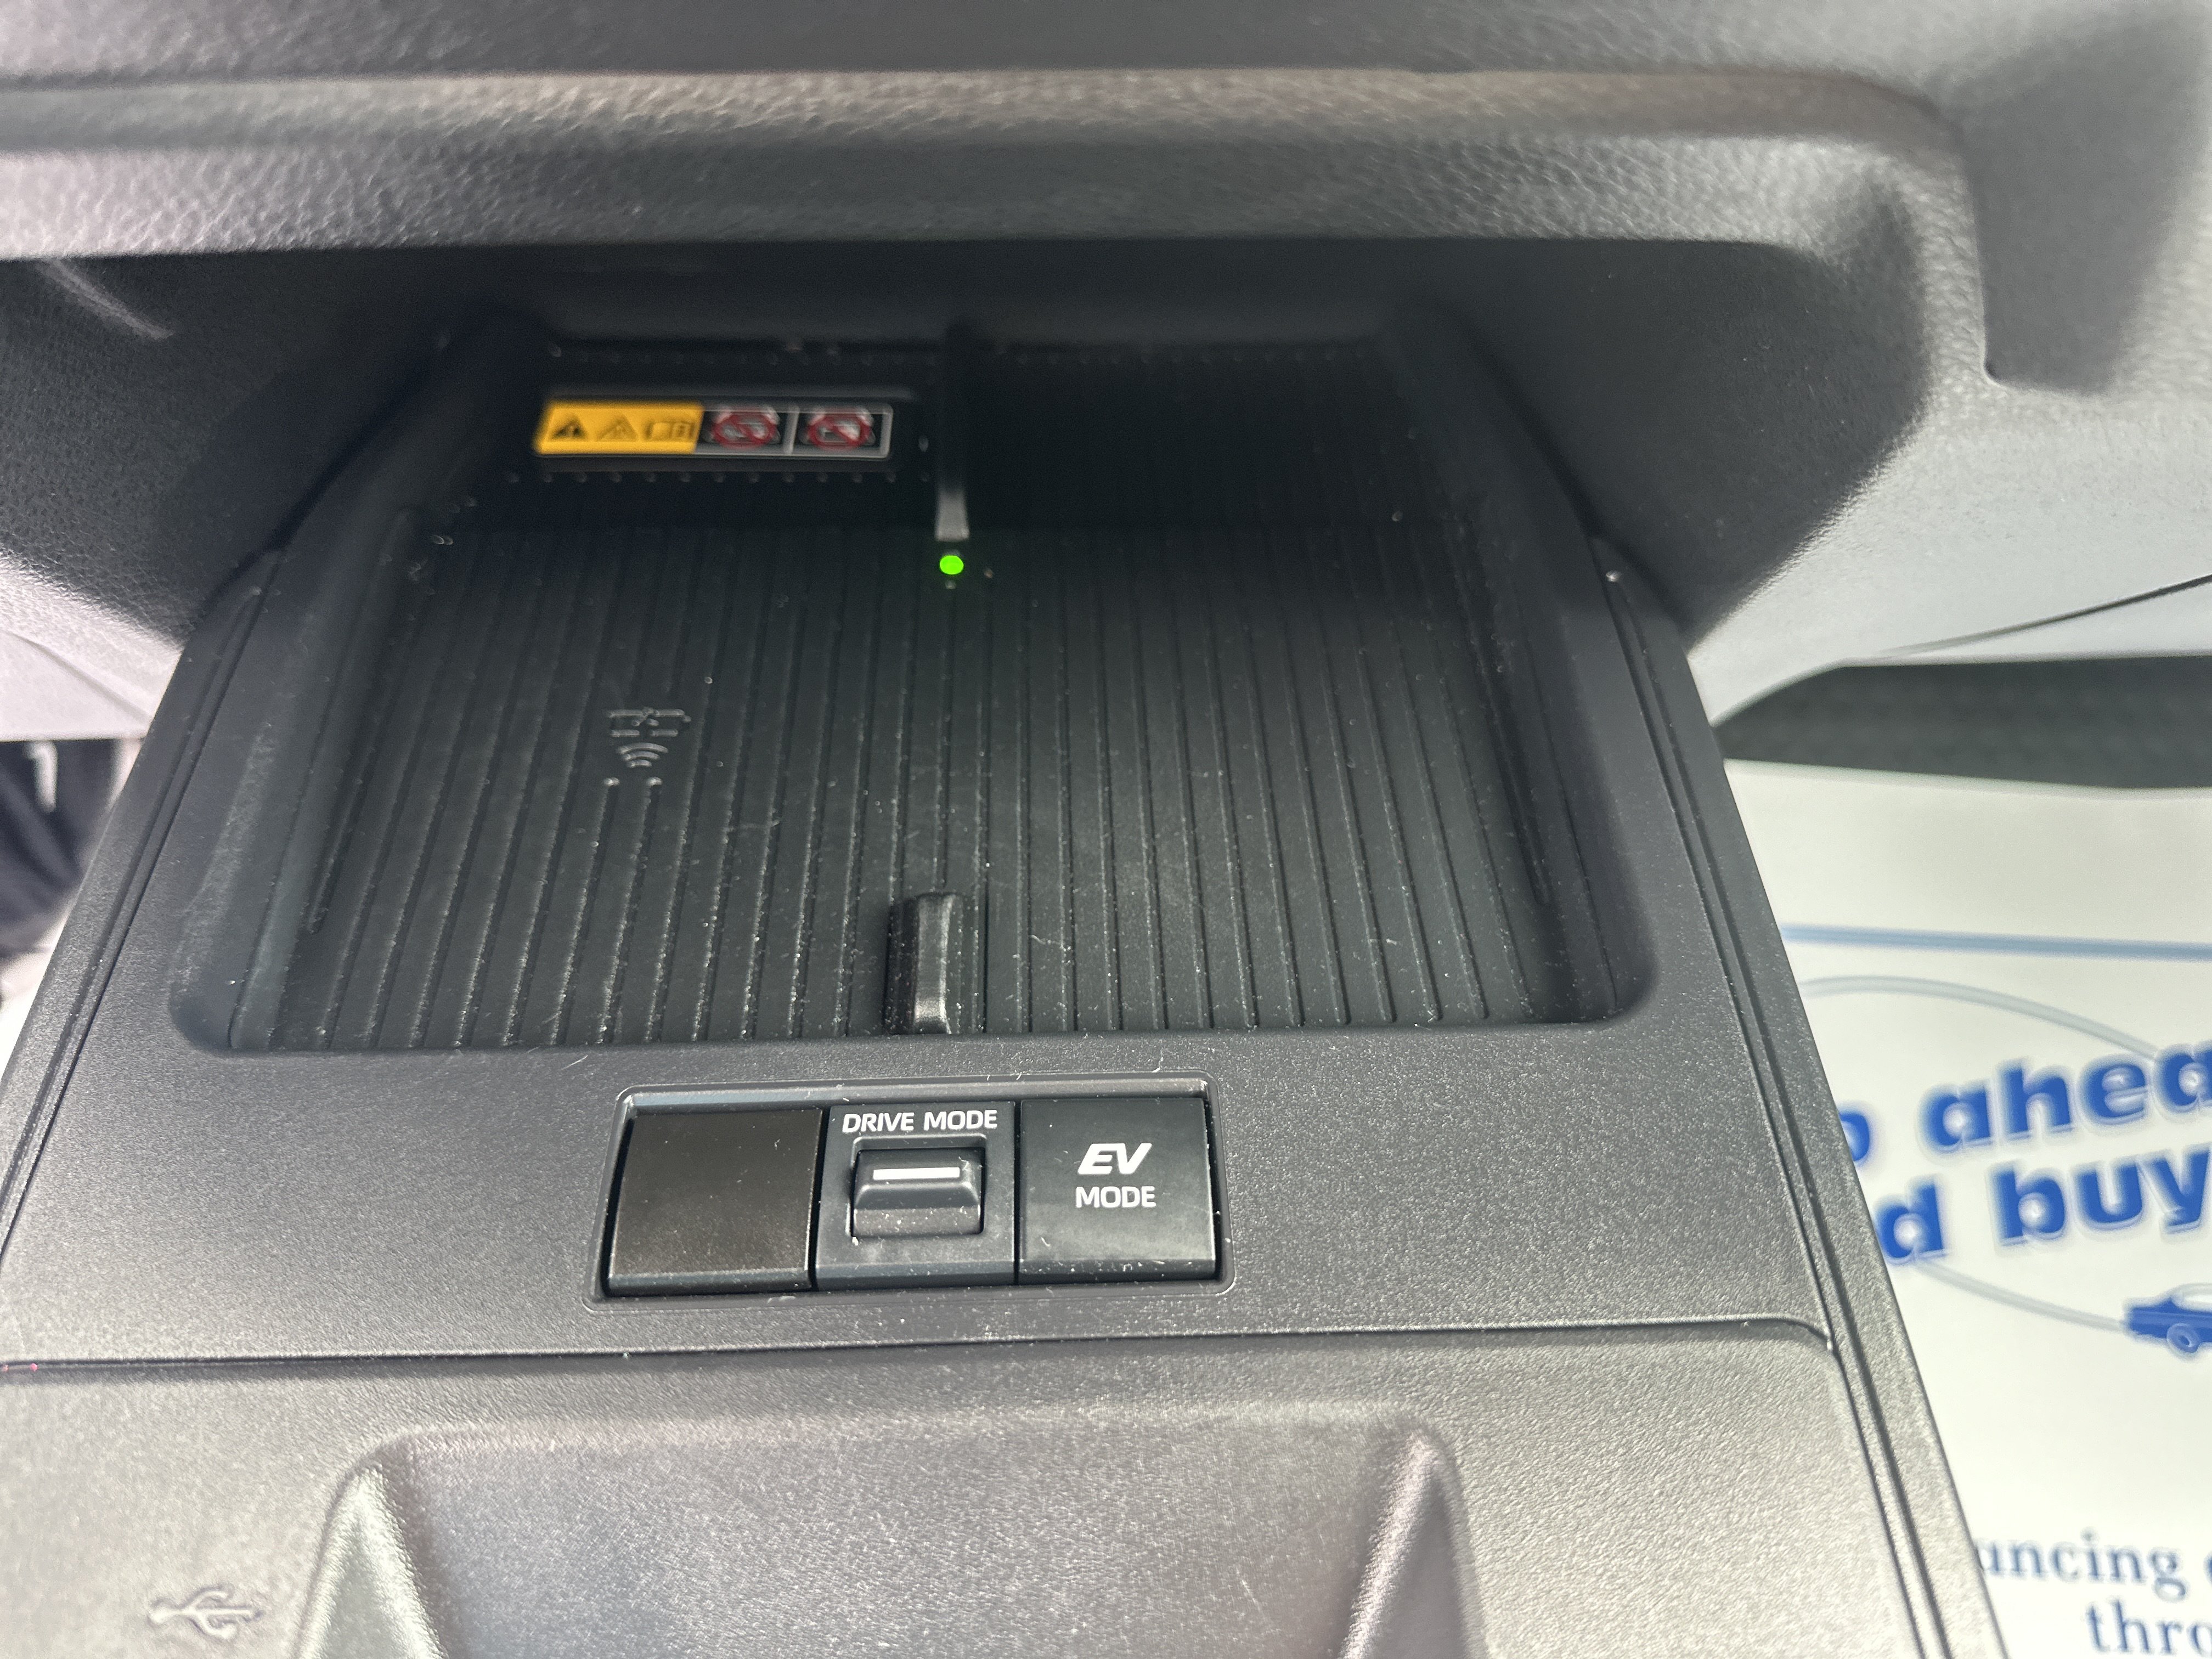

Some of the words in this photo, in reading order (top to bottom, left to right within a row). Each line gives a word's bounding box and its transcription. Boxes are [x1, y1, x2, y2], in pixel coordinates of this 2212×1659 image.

[842, 1111, 915, 1134] DRIVE
[923, 1109, 998, 1131] MODE
[1076, 1142, 1153, 1175] EV
[1075, 1185, 1156, 1209] MODE
[1993, 1143, 2211, 1244] buy
